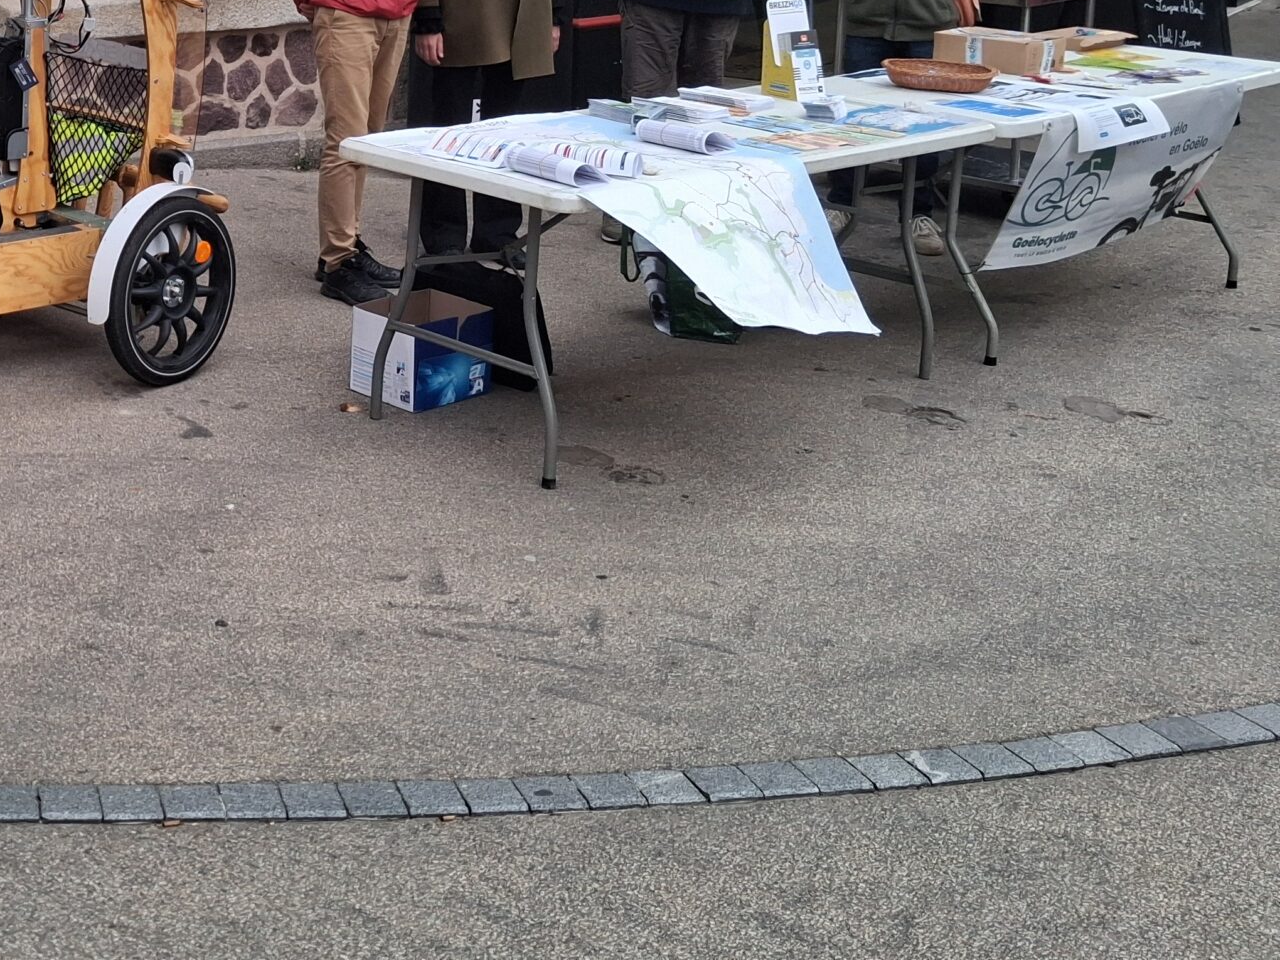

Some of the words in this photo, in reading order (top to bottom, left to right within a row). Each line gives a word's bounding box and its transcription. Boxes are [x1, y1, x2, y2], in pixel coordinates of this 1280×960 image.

[768, 0, 804, 10] BREIZHGO
[1169, 144, 1181, 155] en
[1182, 136, 1209, 153] Goëlo
